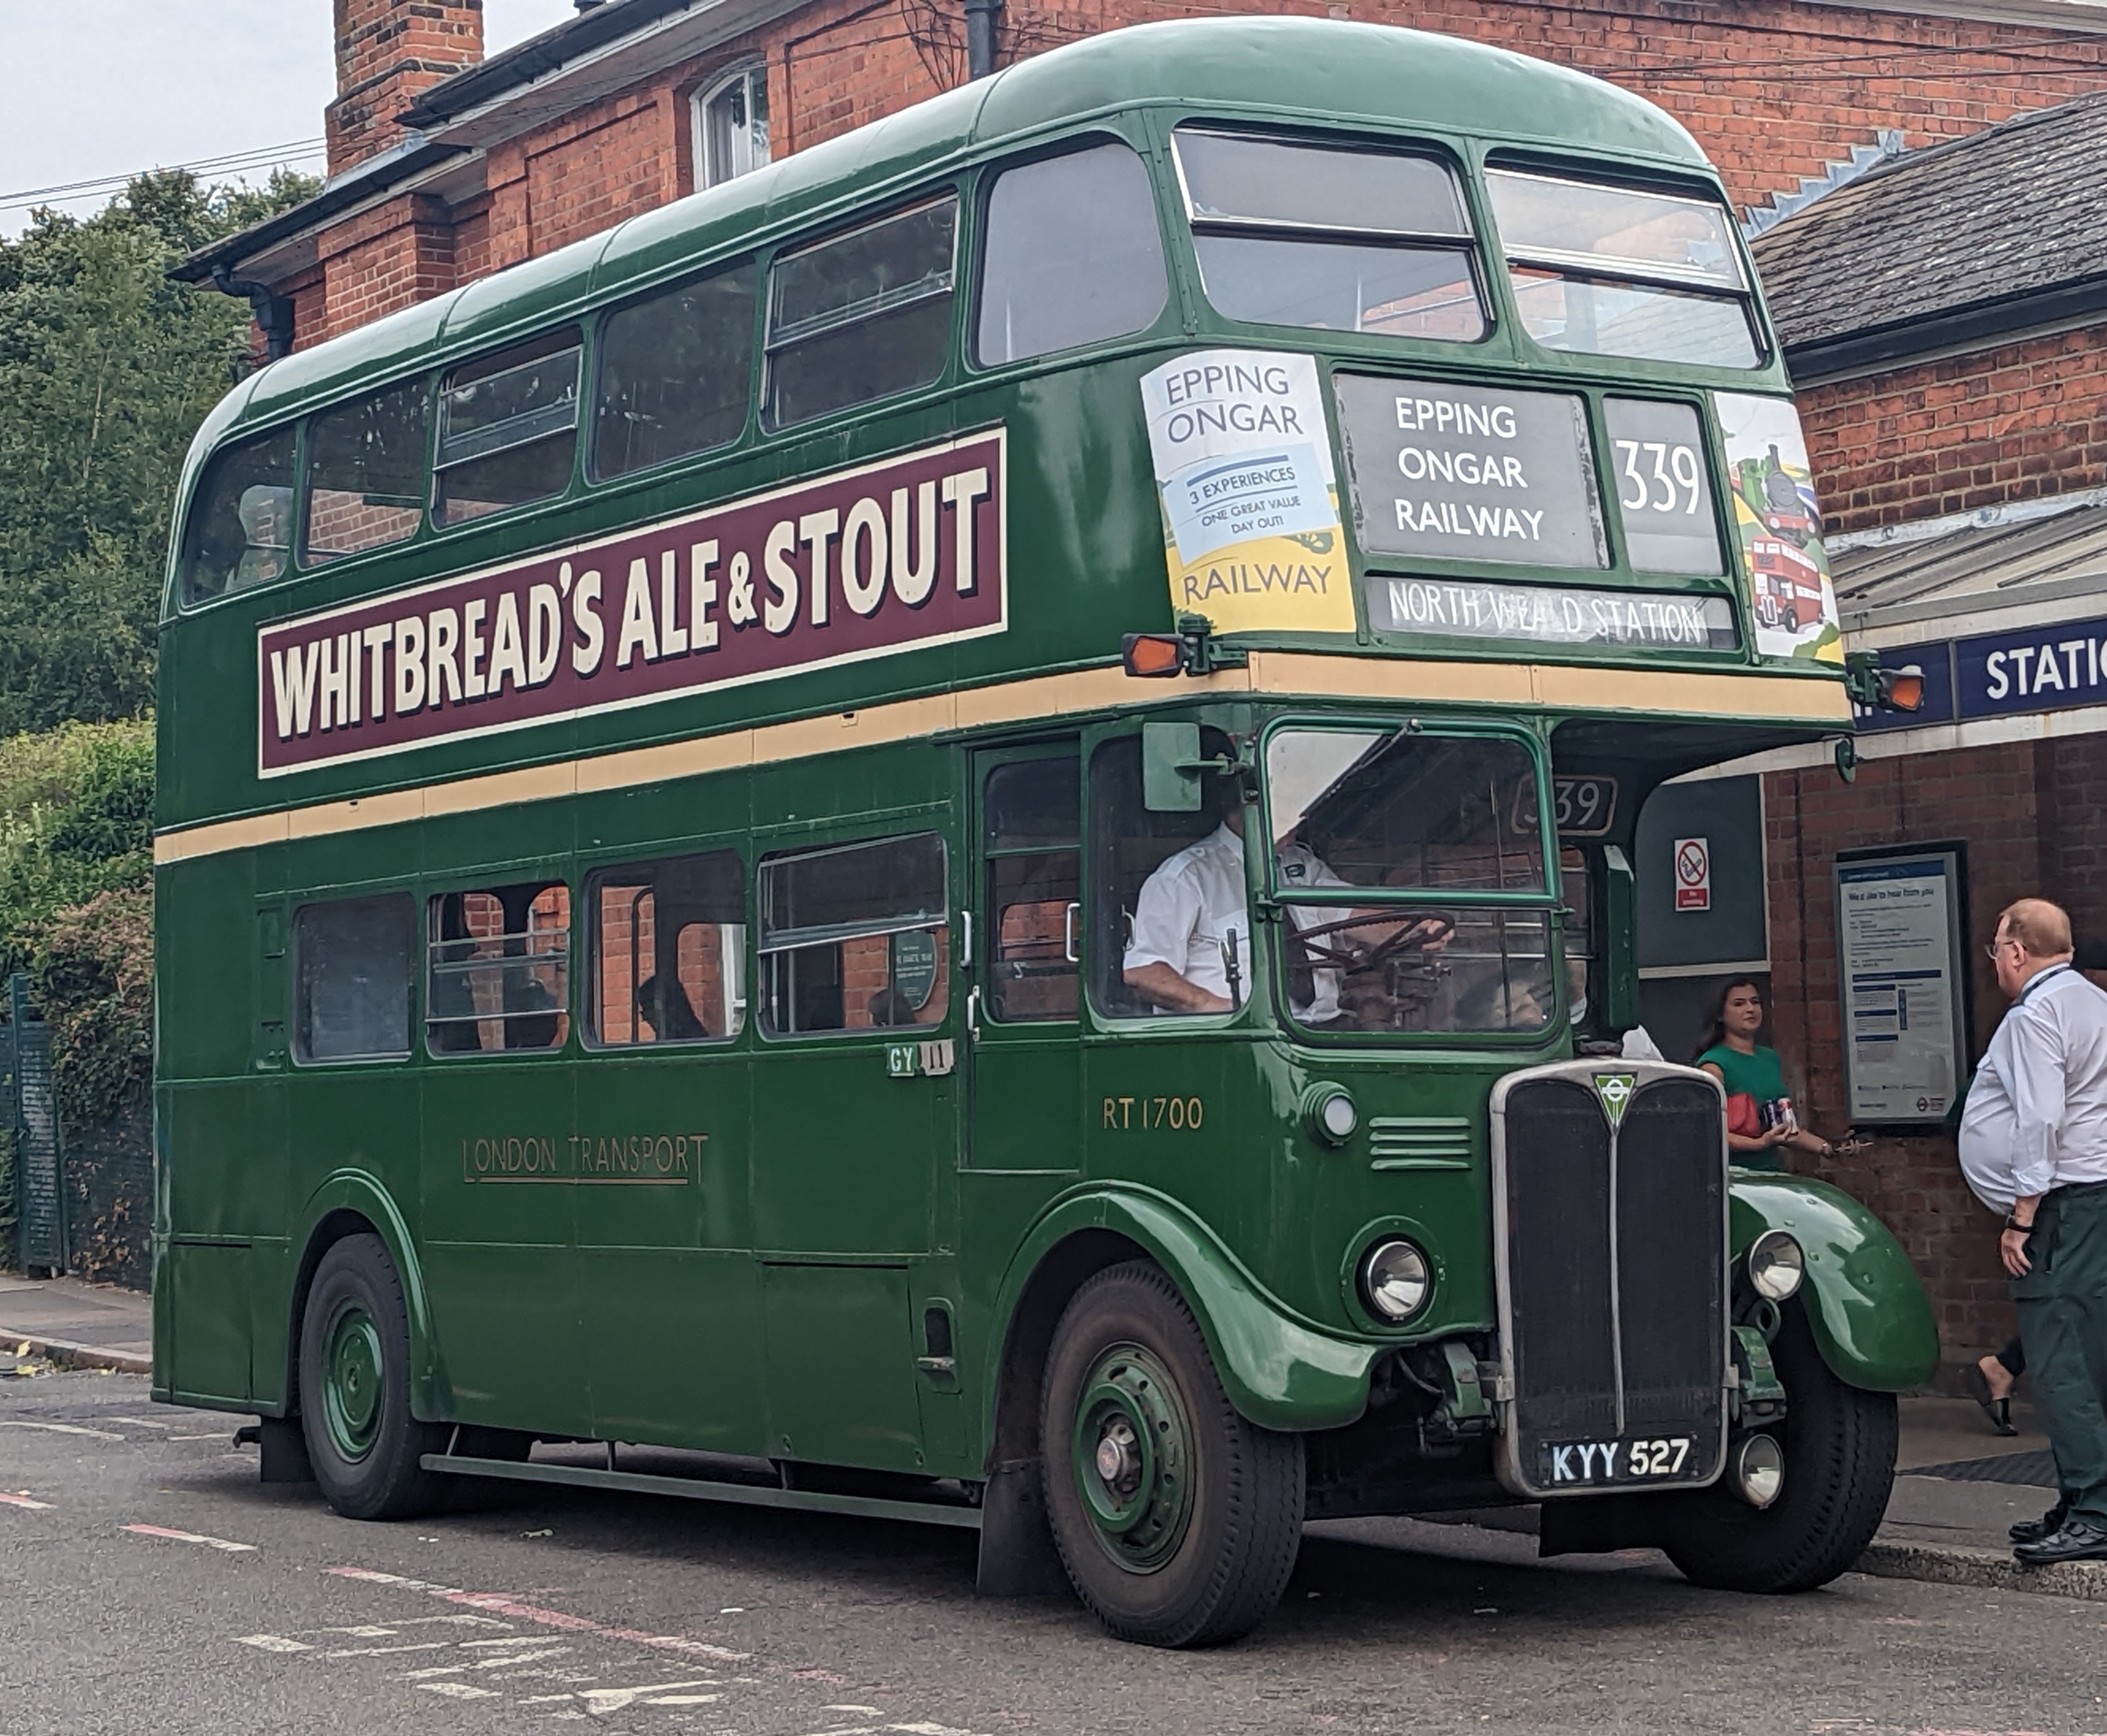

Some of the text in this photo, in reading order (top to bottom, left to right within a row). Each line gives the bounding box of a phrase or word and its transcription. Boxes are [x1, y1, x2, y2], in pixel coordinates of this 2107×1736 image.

[1166, 365, 1289, 406] EPPING
[1168, 403, 1304, 443] ONGAR
[1395, 397, 1517, 439] EPPING
[1189, 467, 1296, 505] 3 EXPERIENCES
[1398, 446, 1529, 489] ONGAR
[1615, 439, 1700, 515] 339
[1201, 495, 1301, 527] ONE GREAT VALUE
[1231, 520, 1255, 534] DAY
[1394, 498, 1544, 541] RAILWAY
[270, 467, 991, 740] WHITBREAD'S ALE & STOUT
[1183, 563, 1332, 605] RAILWAY
[1388, 581, 1481, 627] NORTH
[1591, 598, 1701, 643] STATION
[1986, 638, 2107, 700] STATI
[1524, 781, 1599, 825] 39
[891, 1047, 913, 1072] GY
[1103, 1097, 1203, 1131] RT 1700
[462, 1133, 709, 1184] LONDON TRANSPORT
[1552, 1438, 1690, 1482] KYY 527
